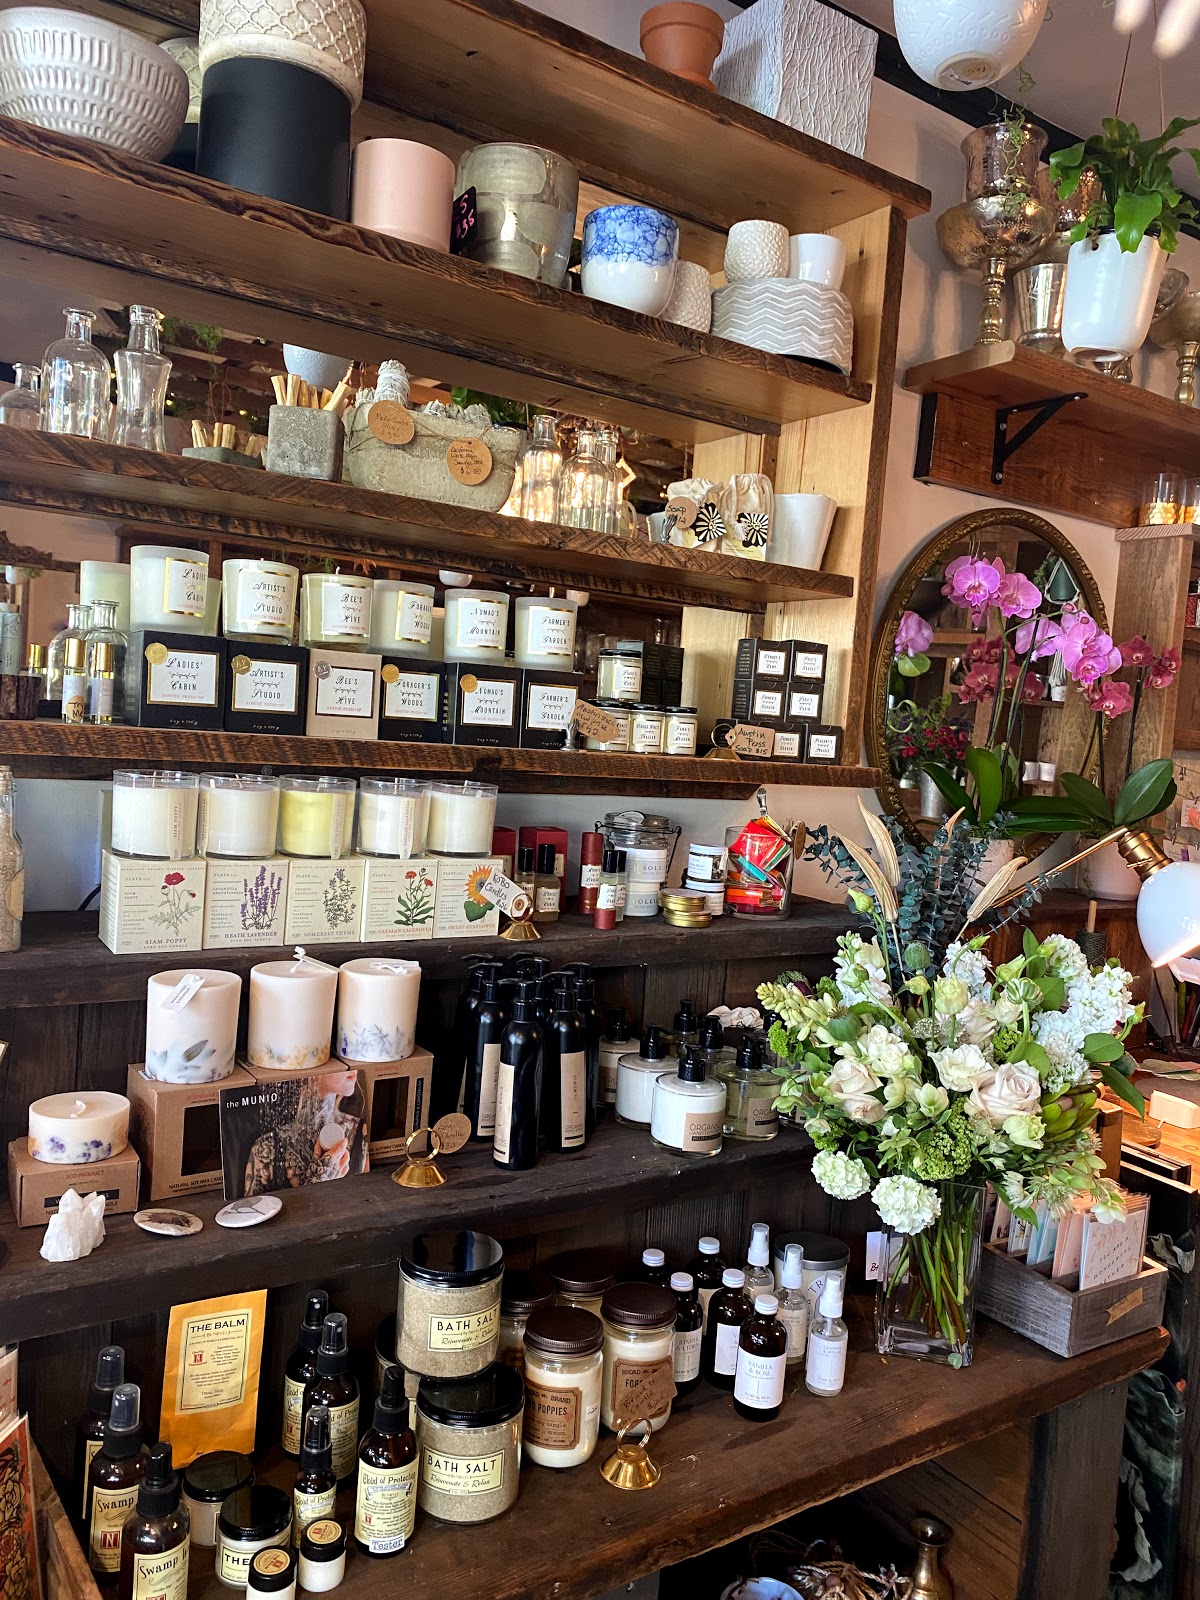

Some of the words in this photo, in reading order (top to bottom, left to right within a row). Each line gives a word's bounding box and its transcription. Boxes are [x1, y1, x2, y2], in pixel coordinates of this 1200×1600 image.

[667, 505, 686, 515] Soap
[253, 582, 286, 593] ARTIST'S
[341, 593, 362, 603] BEE'S
[254, 602, 282, 613] STUDIO
[470, 608, 499, 616] NOMAD'S
[341, 615, 361, 623] HIVE
[541, 616, 570, 626] FARMER'S
[466, 626, 500, 635] MOUNTAIN
[542, 635, 567, 644] GARDEN
[165, 657, 203, 669] LADIES'
[250, 668, 284, 679] ARTIST'S
[335, 675, 358, 685] BEE'S
[394, 679, 431, 690] FORAGER'S
[170, 681, 197, 691] CABIN
[475, 686, 503, 695] NOMAD'S
[252, 688, 281, 699] STUDIO
[539, 692, 569, 702] FARMER'S
[335, 696, 356, 705] HIVE
[400, 698, 423, 706] WOODS
[471, 705, 506, 714] MOUNTAIN
[540, 711, 565, 720] GARDEN
[738, 727, 766, 739] Austin
[492, 872, 510, 888] KOBO
[485, 882, 507, 900] Candles
[242, 1093, 278, 1106] MUNIO
[689, 1122, 720, 1131] ORGANIC
[169, 1181, 190, 1189] NATURAL
[437, 1320, 471, 1331] BATH
[477, 1308, 498, 1327] SALT
[190, 1323, 212, 1333] THE
[214, 1319, 245, 1330] BALM
[441, 1336, 472, 1345] Rejuvenate
[748, 1361, 773, 1369] VANILLA
[550, 1395, 571, 1403] BRAND
[537, 1403, 568, 1416] POPPIES
[427, 1454, 458, 1473] BATH
[466, 1459, 496, 1473] SALT
[430, 1473, 461, 1487] Rejuvenate
[471, 1479, 490, 1488] Relax
[97, 1496, 134, 1512] Swamp
[371, 1539, 403, 1551] Tester
[224, 1553, 250, 1566] THE
[139, 1556, 178, 1579] Swamp
